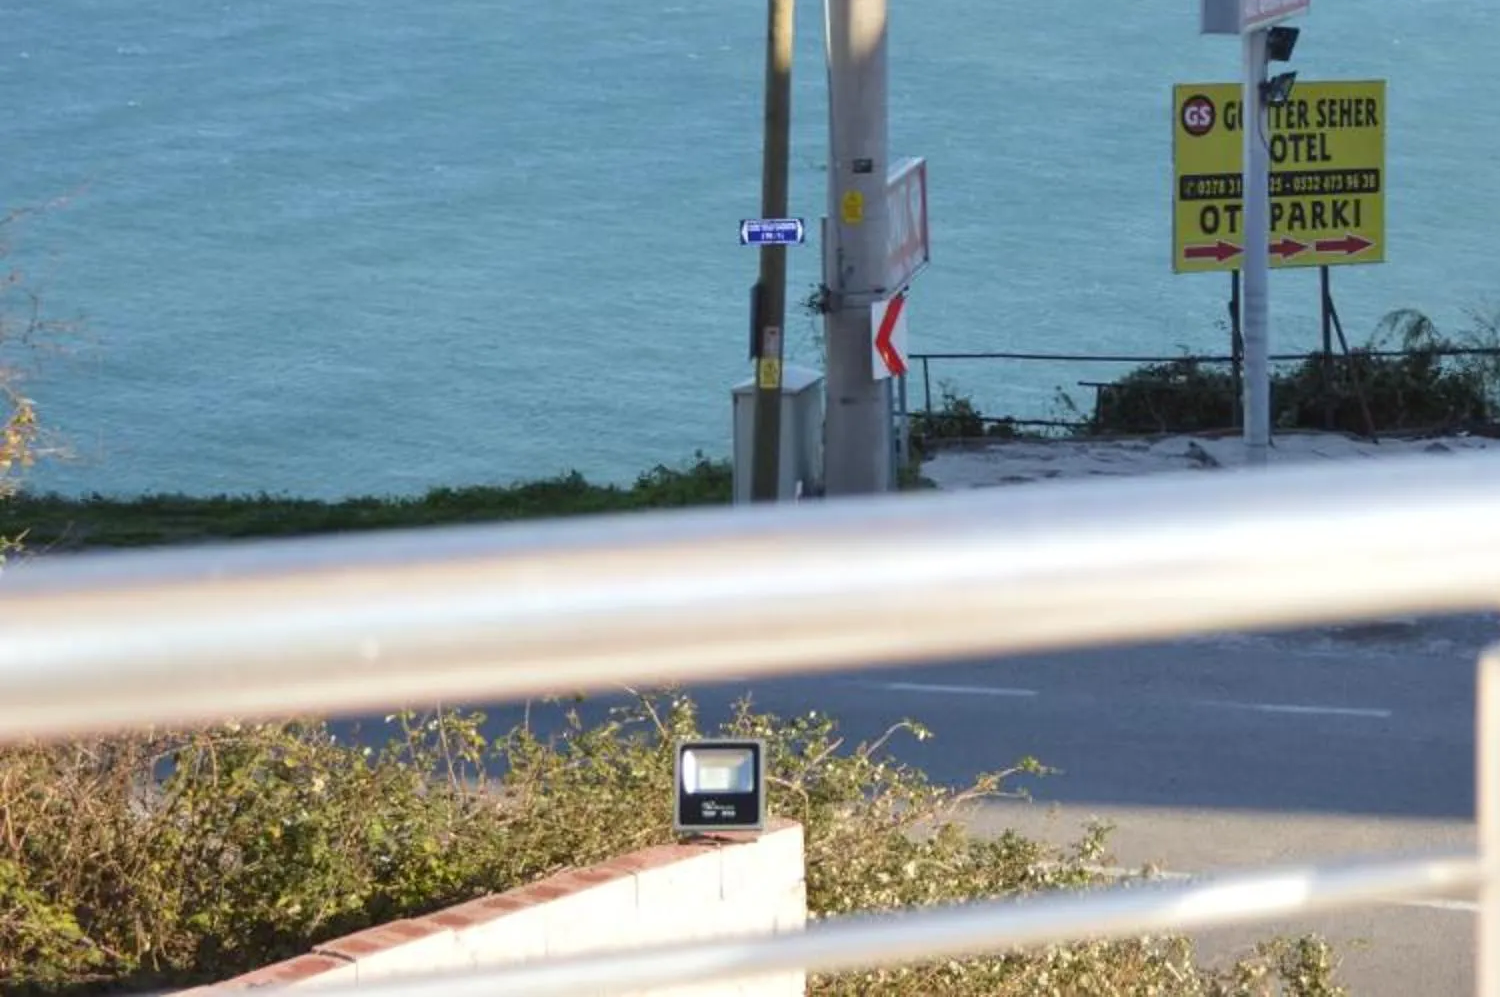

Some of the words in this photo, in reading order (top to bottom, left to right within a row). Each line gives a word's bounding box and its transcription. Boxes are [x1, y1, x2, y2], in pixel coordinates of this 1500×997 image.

[1184, 105, 1212, 127] GS
[1315, 97, 1379, 129] SEHER
[1269, 133, 1332, 163] OTEL
[1200, 198, 1361, 235] OTPARKI
